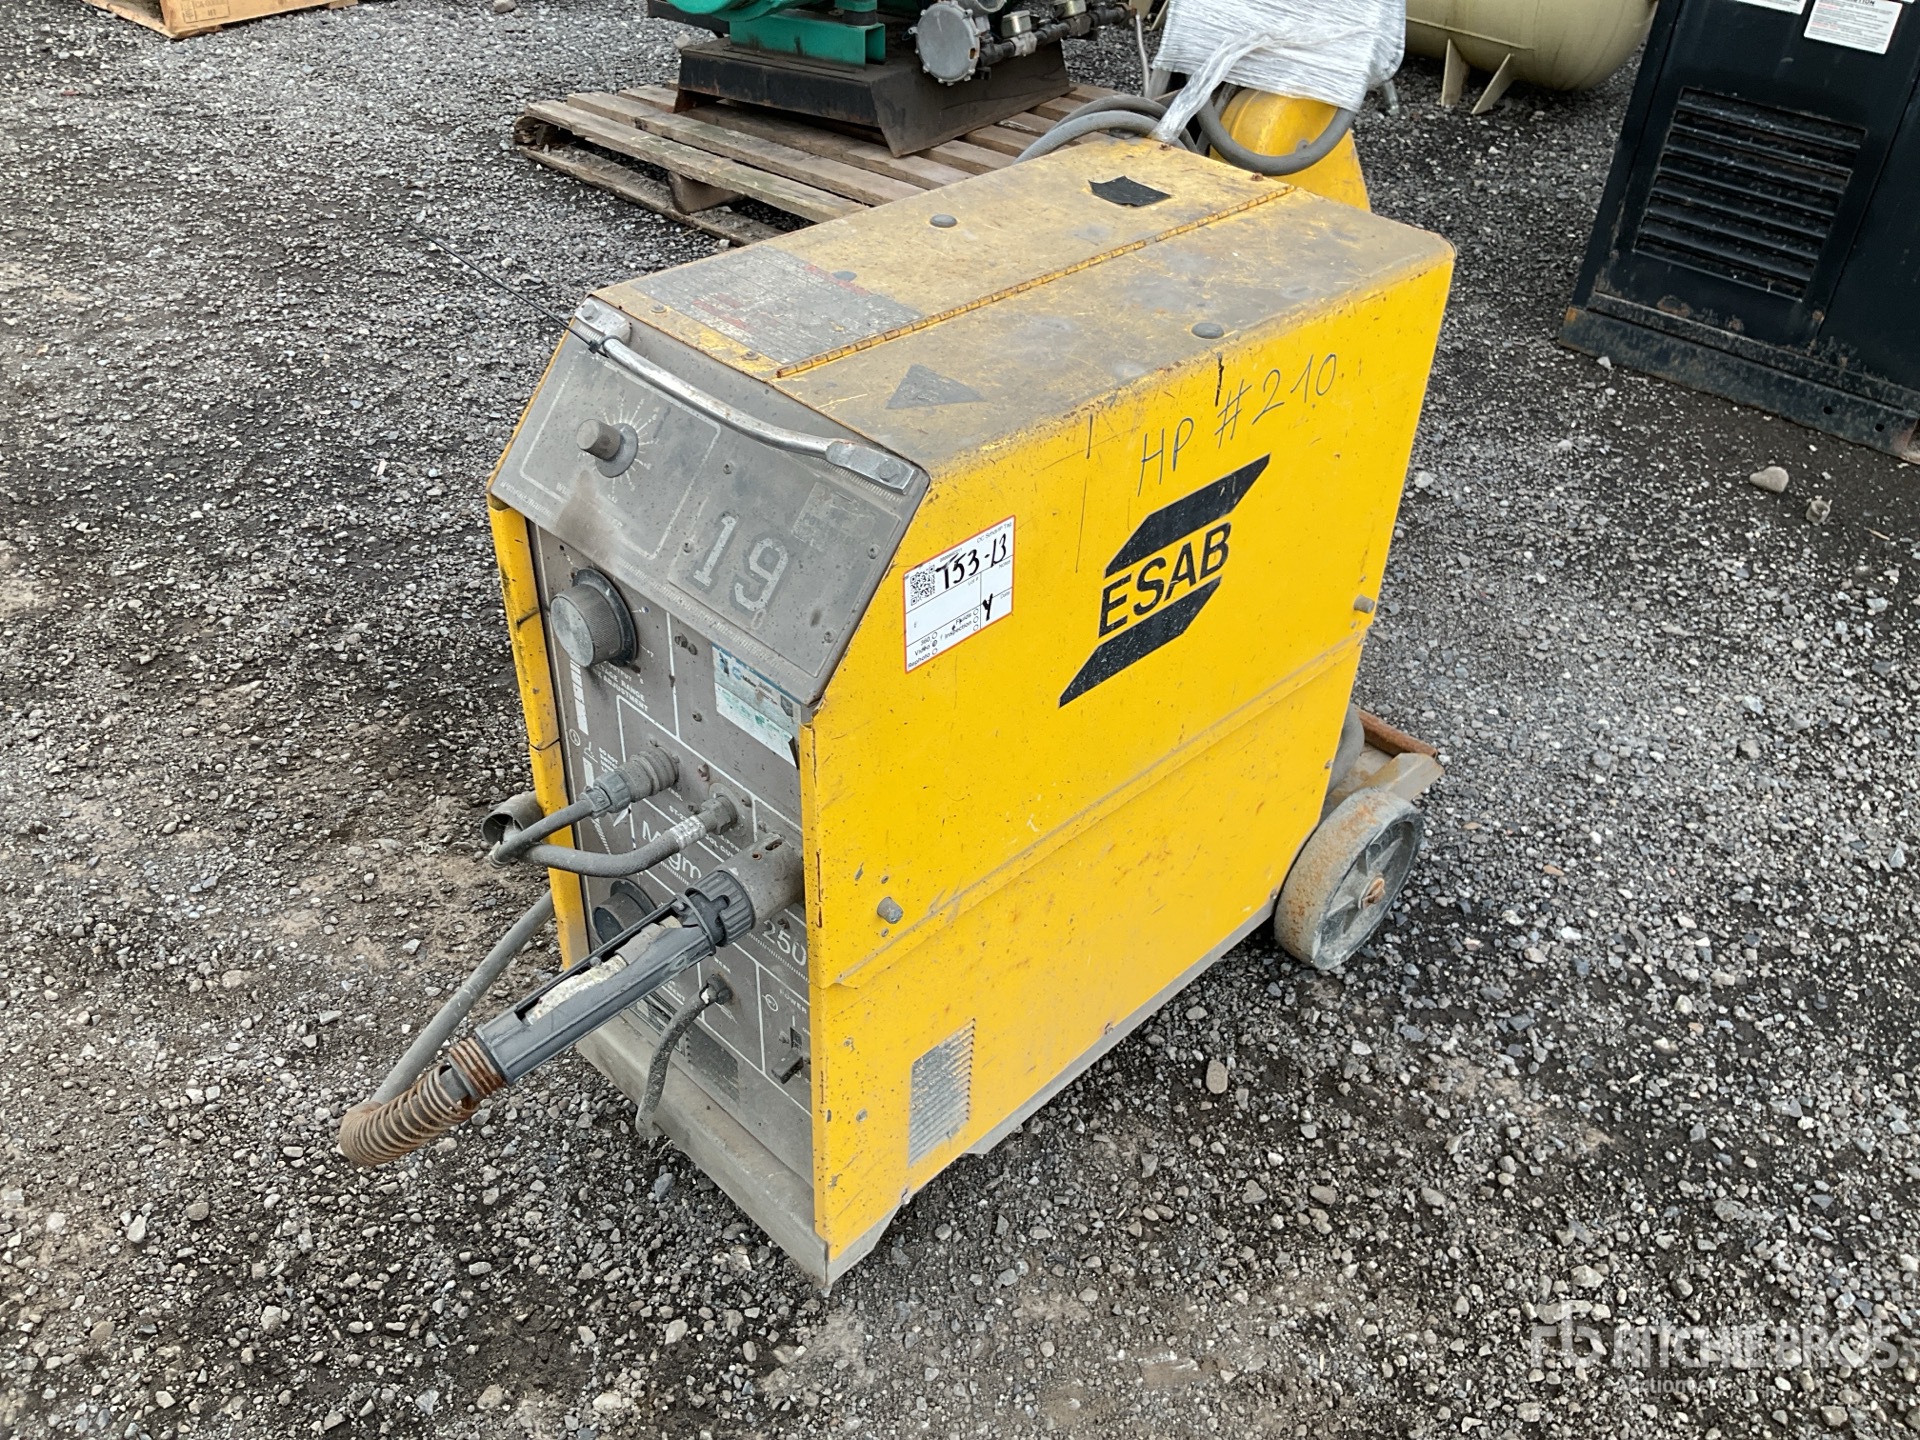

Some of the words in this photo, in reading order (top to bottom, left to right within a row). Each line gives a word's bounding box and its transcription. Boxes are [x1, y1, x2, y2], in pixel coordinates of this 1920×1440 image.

[1137, 417, 1195, 497] HP
[692, 515, 789, 612] 19
[1098, 521, 1232, 639] ESAB
[603, 660, 632, 682] UTPUT
[620, 679, 646, 703] RANGE
[602, 674, 649, 712] ADJUSTMENT
[762, 919, 808, 966] 250
[779, 987, 808, 1014] POWER
